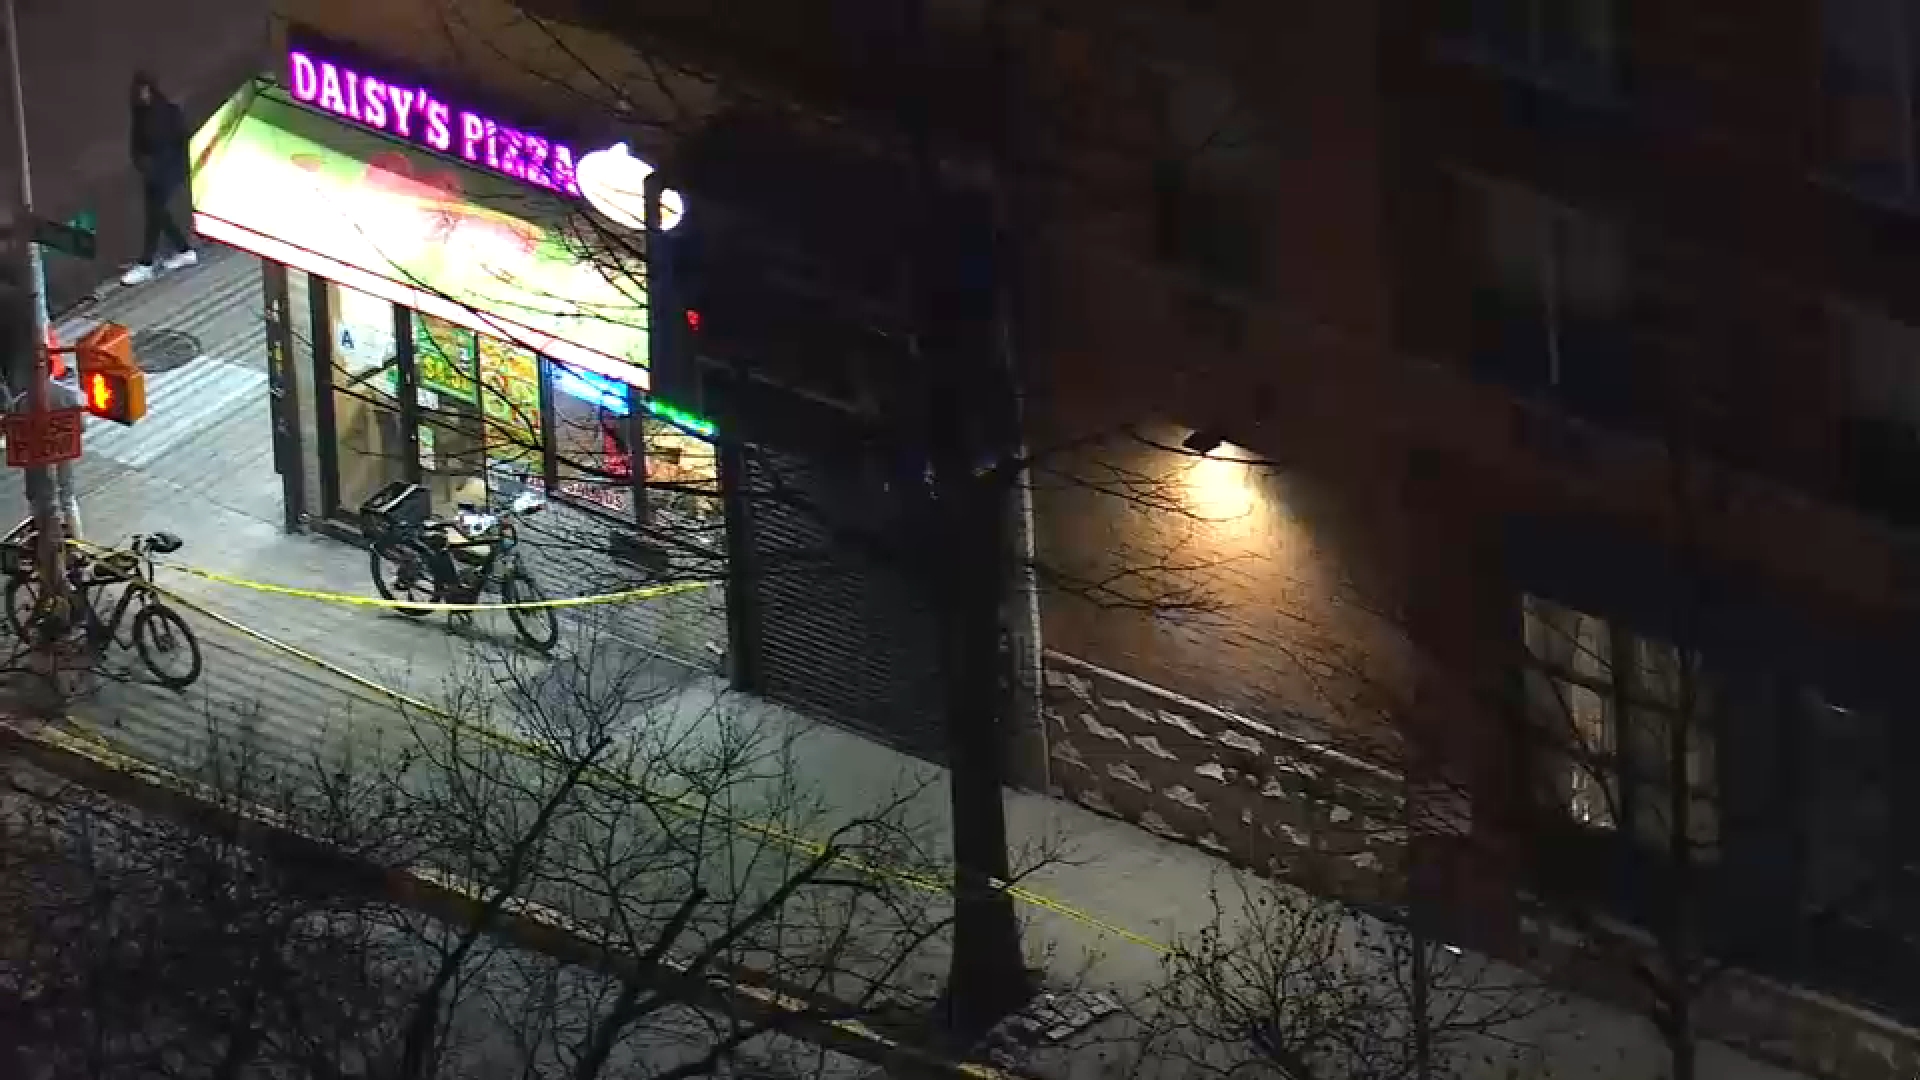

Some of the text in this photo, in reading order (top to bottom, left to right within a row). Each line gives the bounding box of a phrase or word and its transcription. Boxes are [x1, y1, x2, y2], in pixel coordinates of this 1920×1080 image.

[290, 51, 582, 197] DAISY'S PIZZA
[341, 327, 355, 348] A
